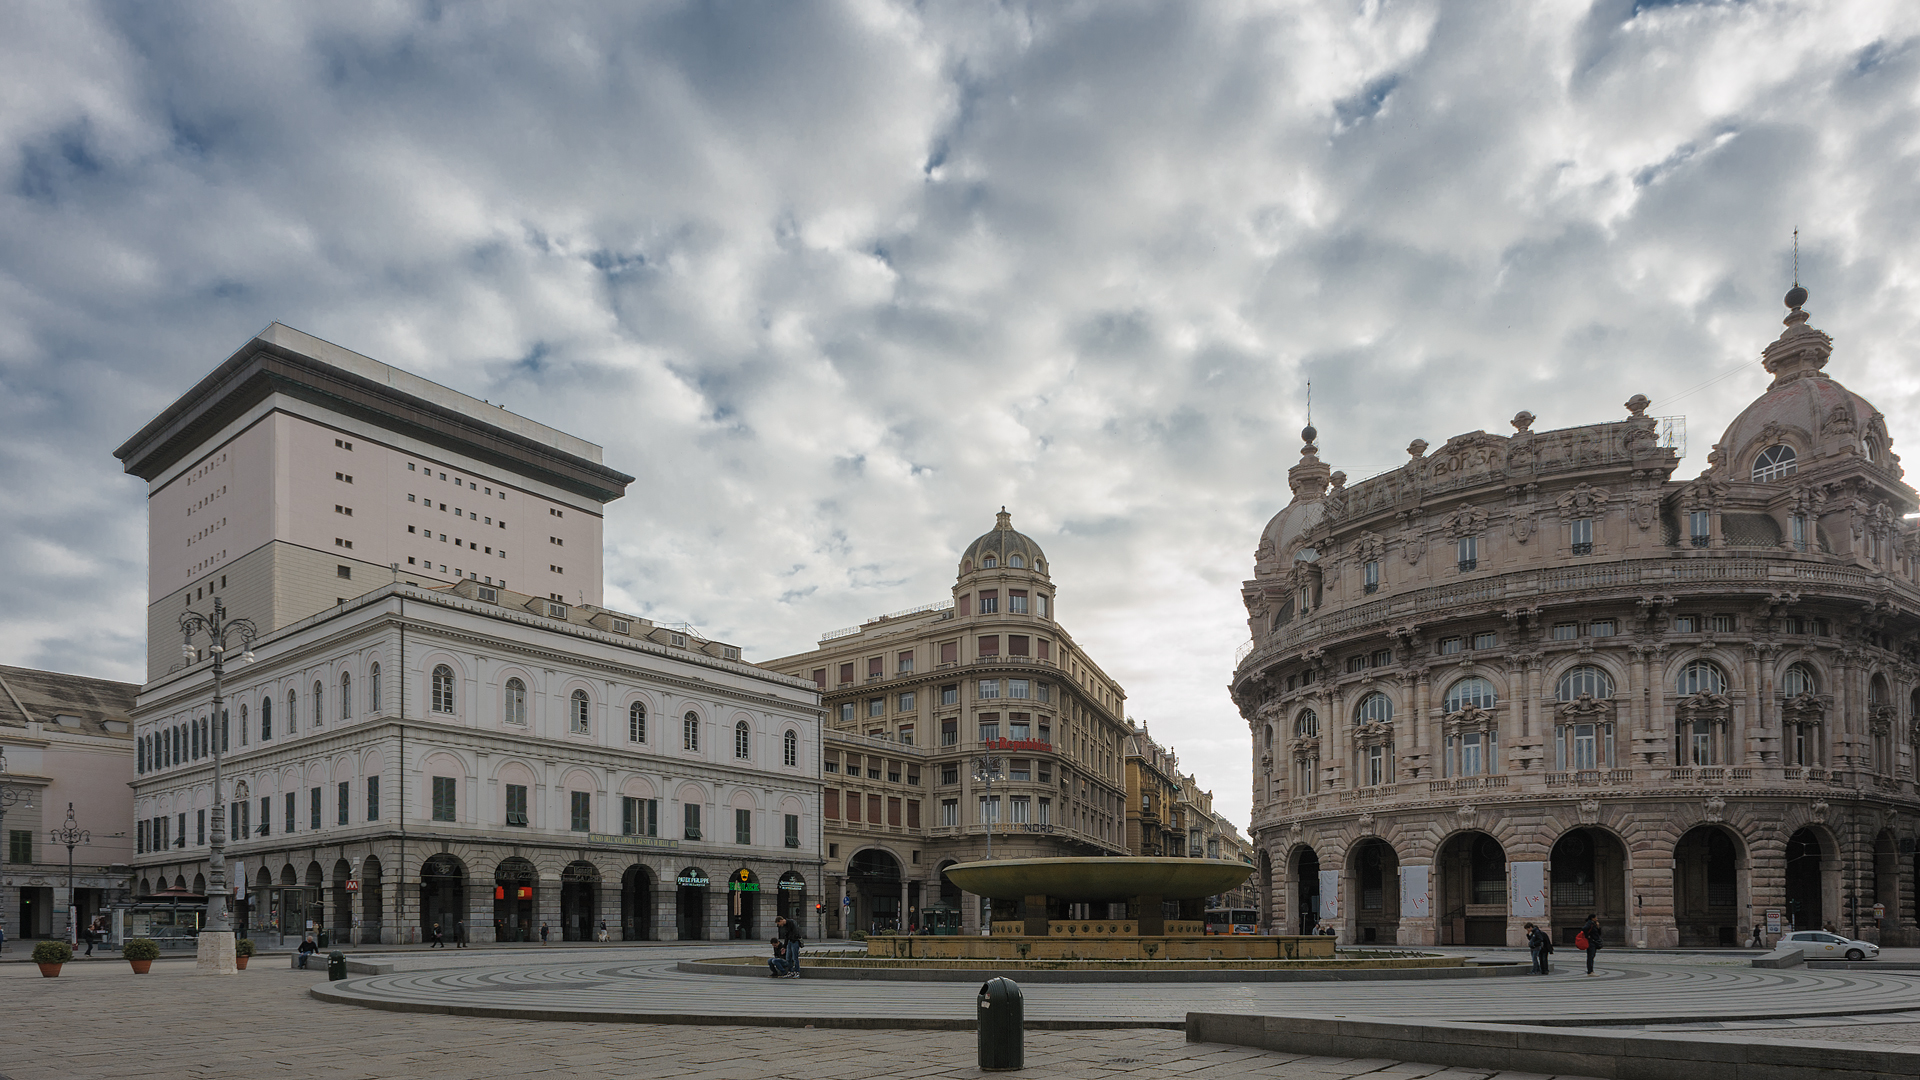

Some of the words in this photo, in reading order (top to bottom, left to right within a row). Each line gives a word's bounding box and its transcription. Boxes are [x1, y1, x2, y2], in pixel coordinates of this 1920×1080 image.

[1433, 447, 1498, 477] BORSA
[986, 737, 996, 749] la
[999, 737, 1053, 752] Repubblica
